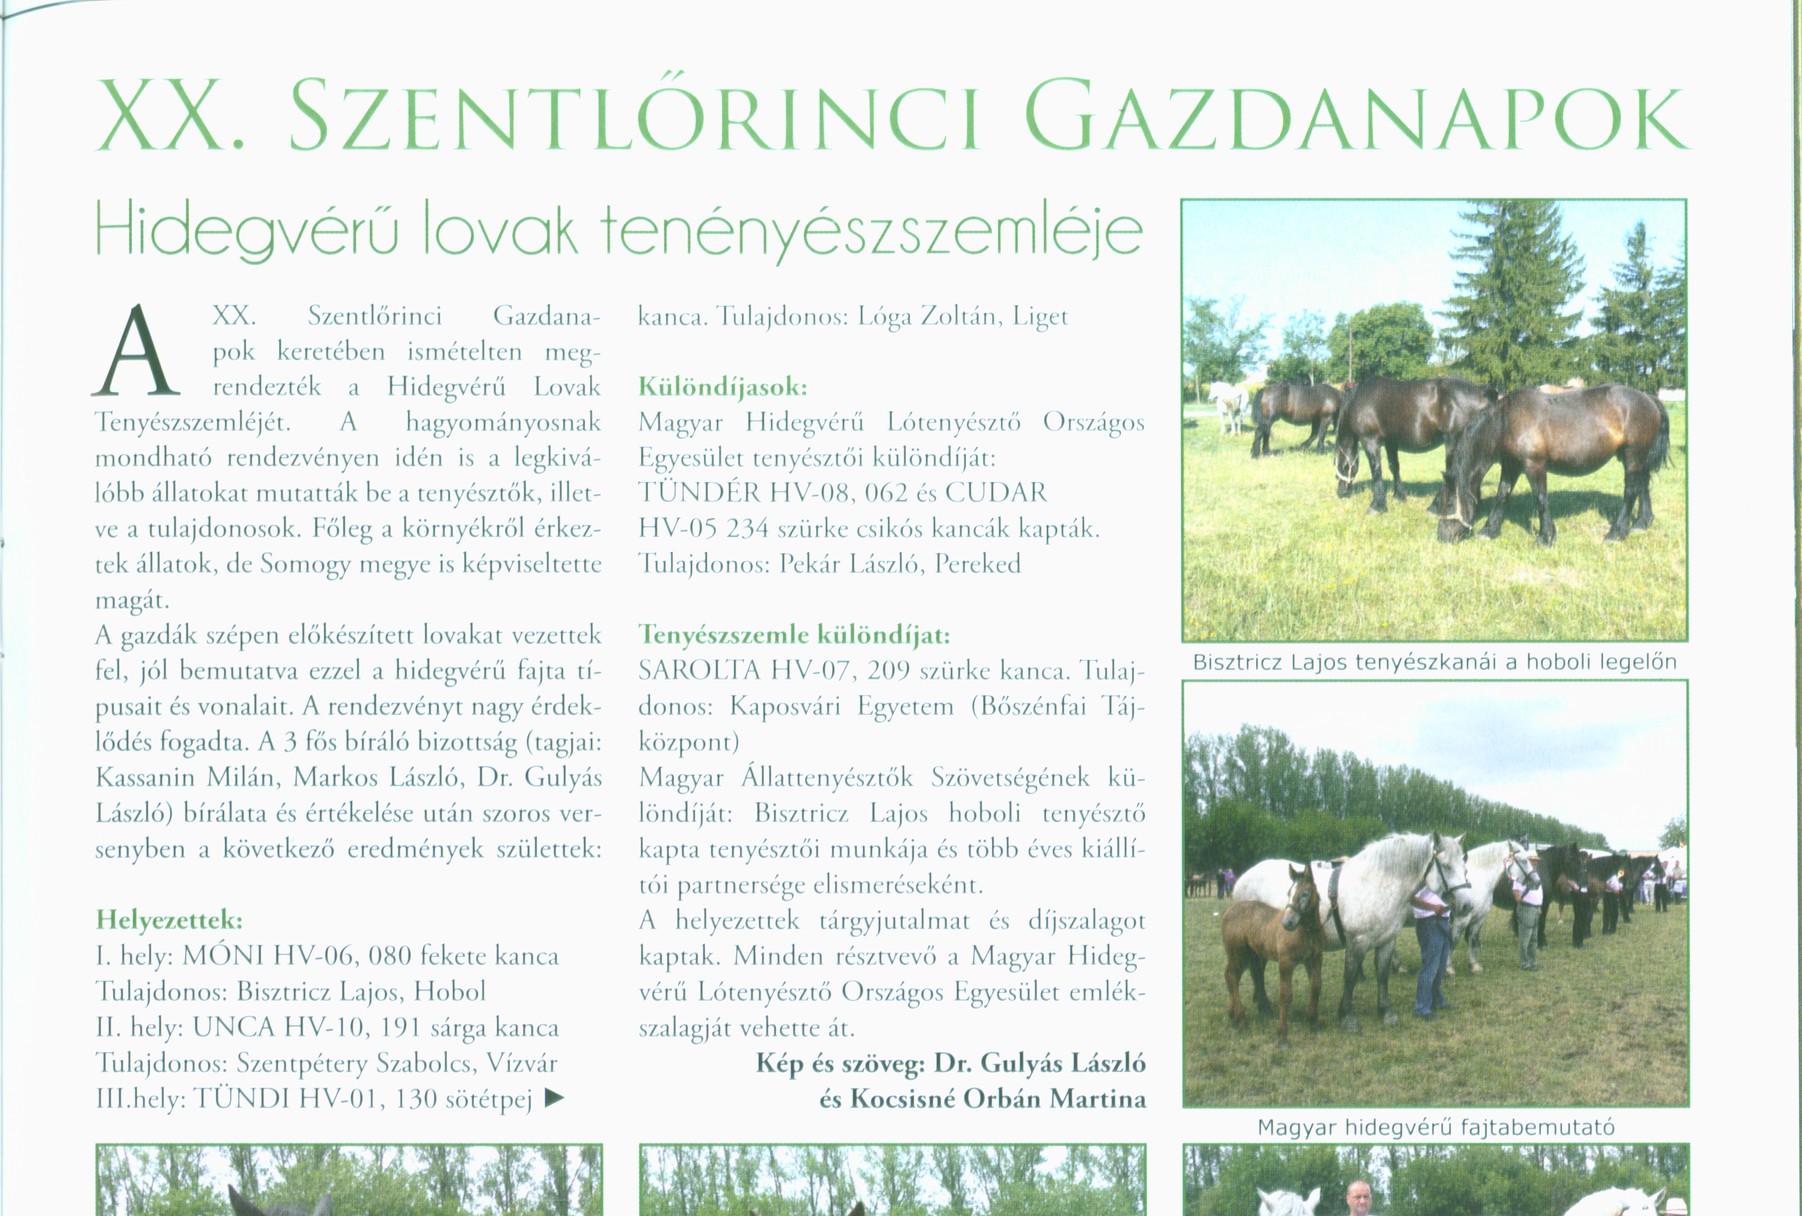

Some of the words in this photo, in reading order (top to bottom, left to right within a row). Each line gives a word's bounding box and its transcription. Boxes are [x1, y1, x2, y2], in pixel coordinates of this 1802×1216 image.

[97, 78, 243, 151] XX.
[290, 69, 980, 151] SZENTLŐRINCI
[1026, 77, 1692, 151] GAZDANAPOK
[97, 198, 398, 265] Hidegvérű
[425, 198, 578, 255] lovak
[600, 198, 1143, 267] tenényészszemléje
[213, 304, 255, 325] XX.
[309, 304, 441, 325] Szentlőrinci
[494, 304, 600, 325] Gazdana-
[91, 303, 181, 397] A
[640, 375, 806, 403] Különdíjasok:
[94, 409, 290, 438] Tenyészszemléjét.
[340, 411, 356, 431] A
[407, 410, 600, 439] hagyományosnak
[640, 411, 723, 439] Magyar
[747, 410, 863, 439] Hidegvérű
[888, 411, 1020, 438] Lótenyésztő
[1044, 411, 1144, 438] Országos
[95, 525, 118, 538] ve
[128, 525, 138, 538] a
[149, 516, 301, 544] tulajdonosok.
[313, 516, 373, 545] Főleg
[382, 525, 392, 537] a
[403, 516, 524, 544] környékről
[535, 516, 601, 537] érkez-
[640, 517, 716, 539] HV-05
[727, 517, 768, 539] 234
[778, 516, 848, 538] szürke
[857, 516, 922, 538] csikós
[932, 516, 1010, 537] kancák
[1019, 516, 1099, 545] kapták.
[95, 624, 112, 644] A
[121, 622, 197, 652] gazdák
[207, 624, 278, 651] szépen
[289, 622, 413, 644] előkészített
[424, 622, 502, 644] lovakat
[512, 622, 602, 644] vezettek
[638, 623, 809, 651] Tenyészszemle
[818, 623, 949, 651] különdíjat:
[639, 659, 760, 680] SAROLTA
[772, 659, 856, 682] HV-07,
[868, 660, 909, 680] 209
[920, 658, 990, 680] szürke
[1001, 658, 1070, 680] kanca.
[1079, 658, 1144, 686] Tulaj-
[1194, 654, 1282, 670] Bisztricz
[1292, 654, 1347, 674] Lajos
[1356, 651, 1496, 674] tenyészkanái
[1506, 657, 1516, 670] a
[1528, 653, 1590, 670] hoboli
[1601, 651, 1676, 674] legelőn
[639, 694, 712, 715] donos:
[731, 695, 839, 722] Kaposvári
[858, 695, 953, 723] Egyetem
[972, 694, 1085, 718] (Bőszénfai
[1101, 695, 1144, 721] Táj-
[96, 729, 151, 751] lődés
[160, 729, 248, 759] fogadta.
[258, 730, 275, 751] A
[284, 731, 296, 752] 3
[306, 729, 336, 751] fős
[345, 729, 409, 751] bíráló
[418, 729, 517, 759] bizottság
[526, 730, 600, 759] (tagjai:
[640, 766, 724, 794] Magyar
[742, 761, 913, 794] Állattenyésztők
[932, 765, 1090, 794] Szövetségének
[1109, 765, 1145, 787] kü-
[96, 836, 185, 865] senyben
[199, 845, 210, 858] a
[224, 836, 334, 858] következő
[348, 836, 484, 865] eredmények
[497, 836, 600, 858] születtek:
[640, 874, 667, 894] tói
[678, 874, 805, 901] partnersége
[814, 872, 982, 894] elismeréseként.
[96, 907, 242, 936] Helyezettek:
[95, 979, 226, 1008] Tulajdonos:
[238, 980, 331, 1001] Bisztricz
[340, 980, 404, 1008] Lajos,
[415, 979, 485, 1001] Hobol
[640, 981, 686, 1001] vérű
[699, 981, 831, 1008] Lótenyésztő
[842, 980, 943, 1009] Országos
[955, 979, 1059, 1009] Egyesület
[1070, 979, 1145, 1001] emlék-
[756, 1052, 804, 1080] Kép
[812, 1052, 834, 1073] és
[842, 1054, 924, 1080] szöveg:
[934, 1052, 972, 1072] Dr.
[981, 1051, 1062, 1080] Gulyás
[1071, 1051, 1146, 1072] László
[97, 1088, 186, 1116] III.hely:
[192, 1083, 289, 1108] TÜNDI
[300, 1088, 387, 1112] HV-01,
[398, 1089, 437, 1109] 130
[446, 1089, 531, 1116] sötétpej
[820, 1088, 841, 1108] és
[851, 1088, 955, 1108] Kocsisné
[964, 1087, 1041, 1108] Orbán
[1050, 1088, 1147, 1108] Martina
[1259, 1119, 1337, 1140] Magyar
[1346, 1117, 1451, 1140] hidegvérű
[1462, 1117, 1615, 1140] fajtabemutató
